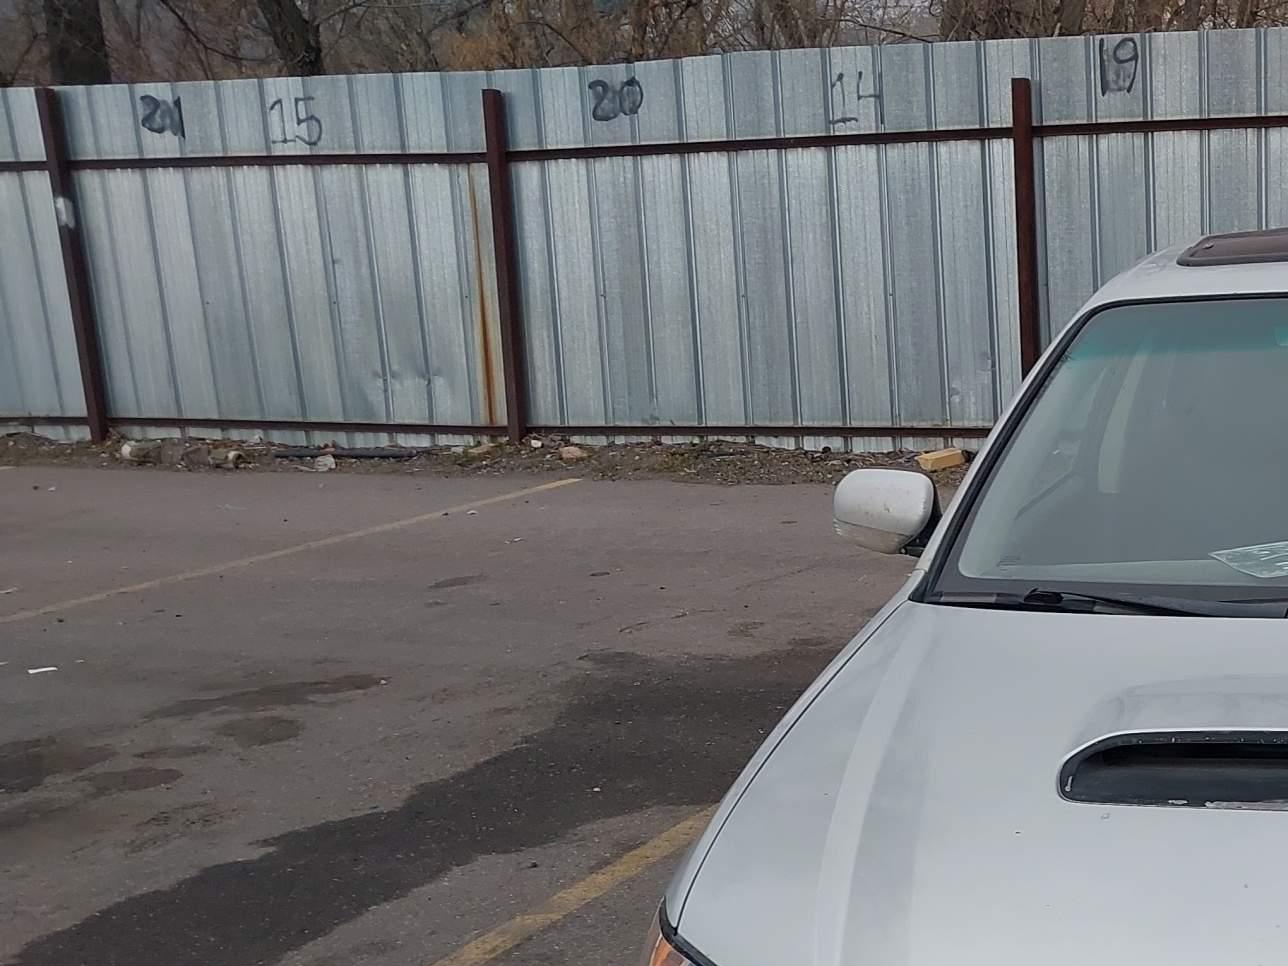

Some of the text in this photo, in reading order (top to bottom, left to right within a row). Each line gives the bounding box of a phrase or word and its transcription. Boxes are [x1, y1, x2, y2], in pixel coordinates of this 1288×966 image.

[1099, 37, 1139, 98] 19
[268, 96, 323, 146] 15
[587, 76, 644, 122] 20
[829, 70, 885, 125] 14
